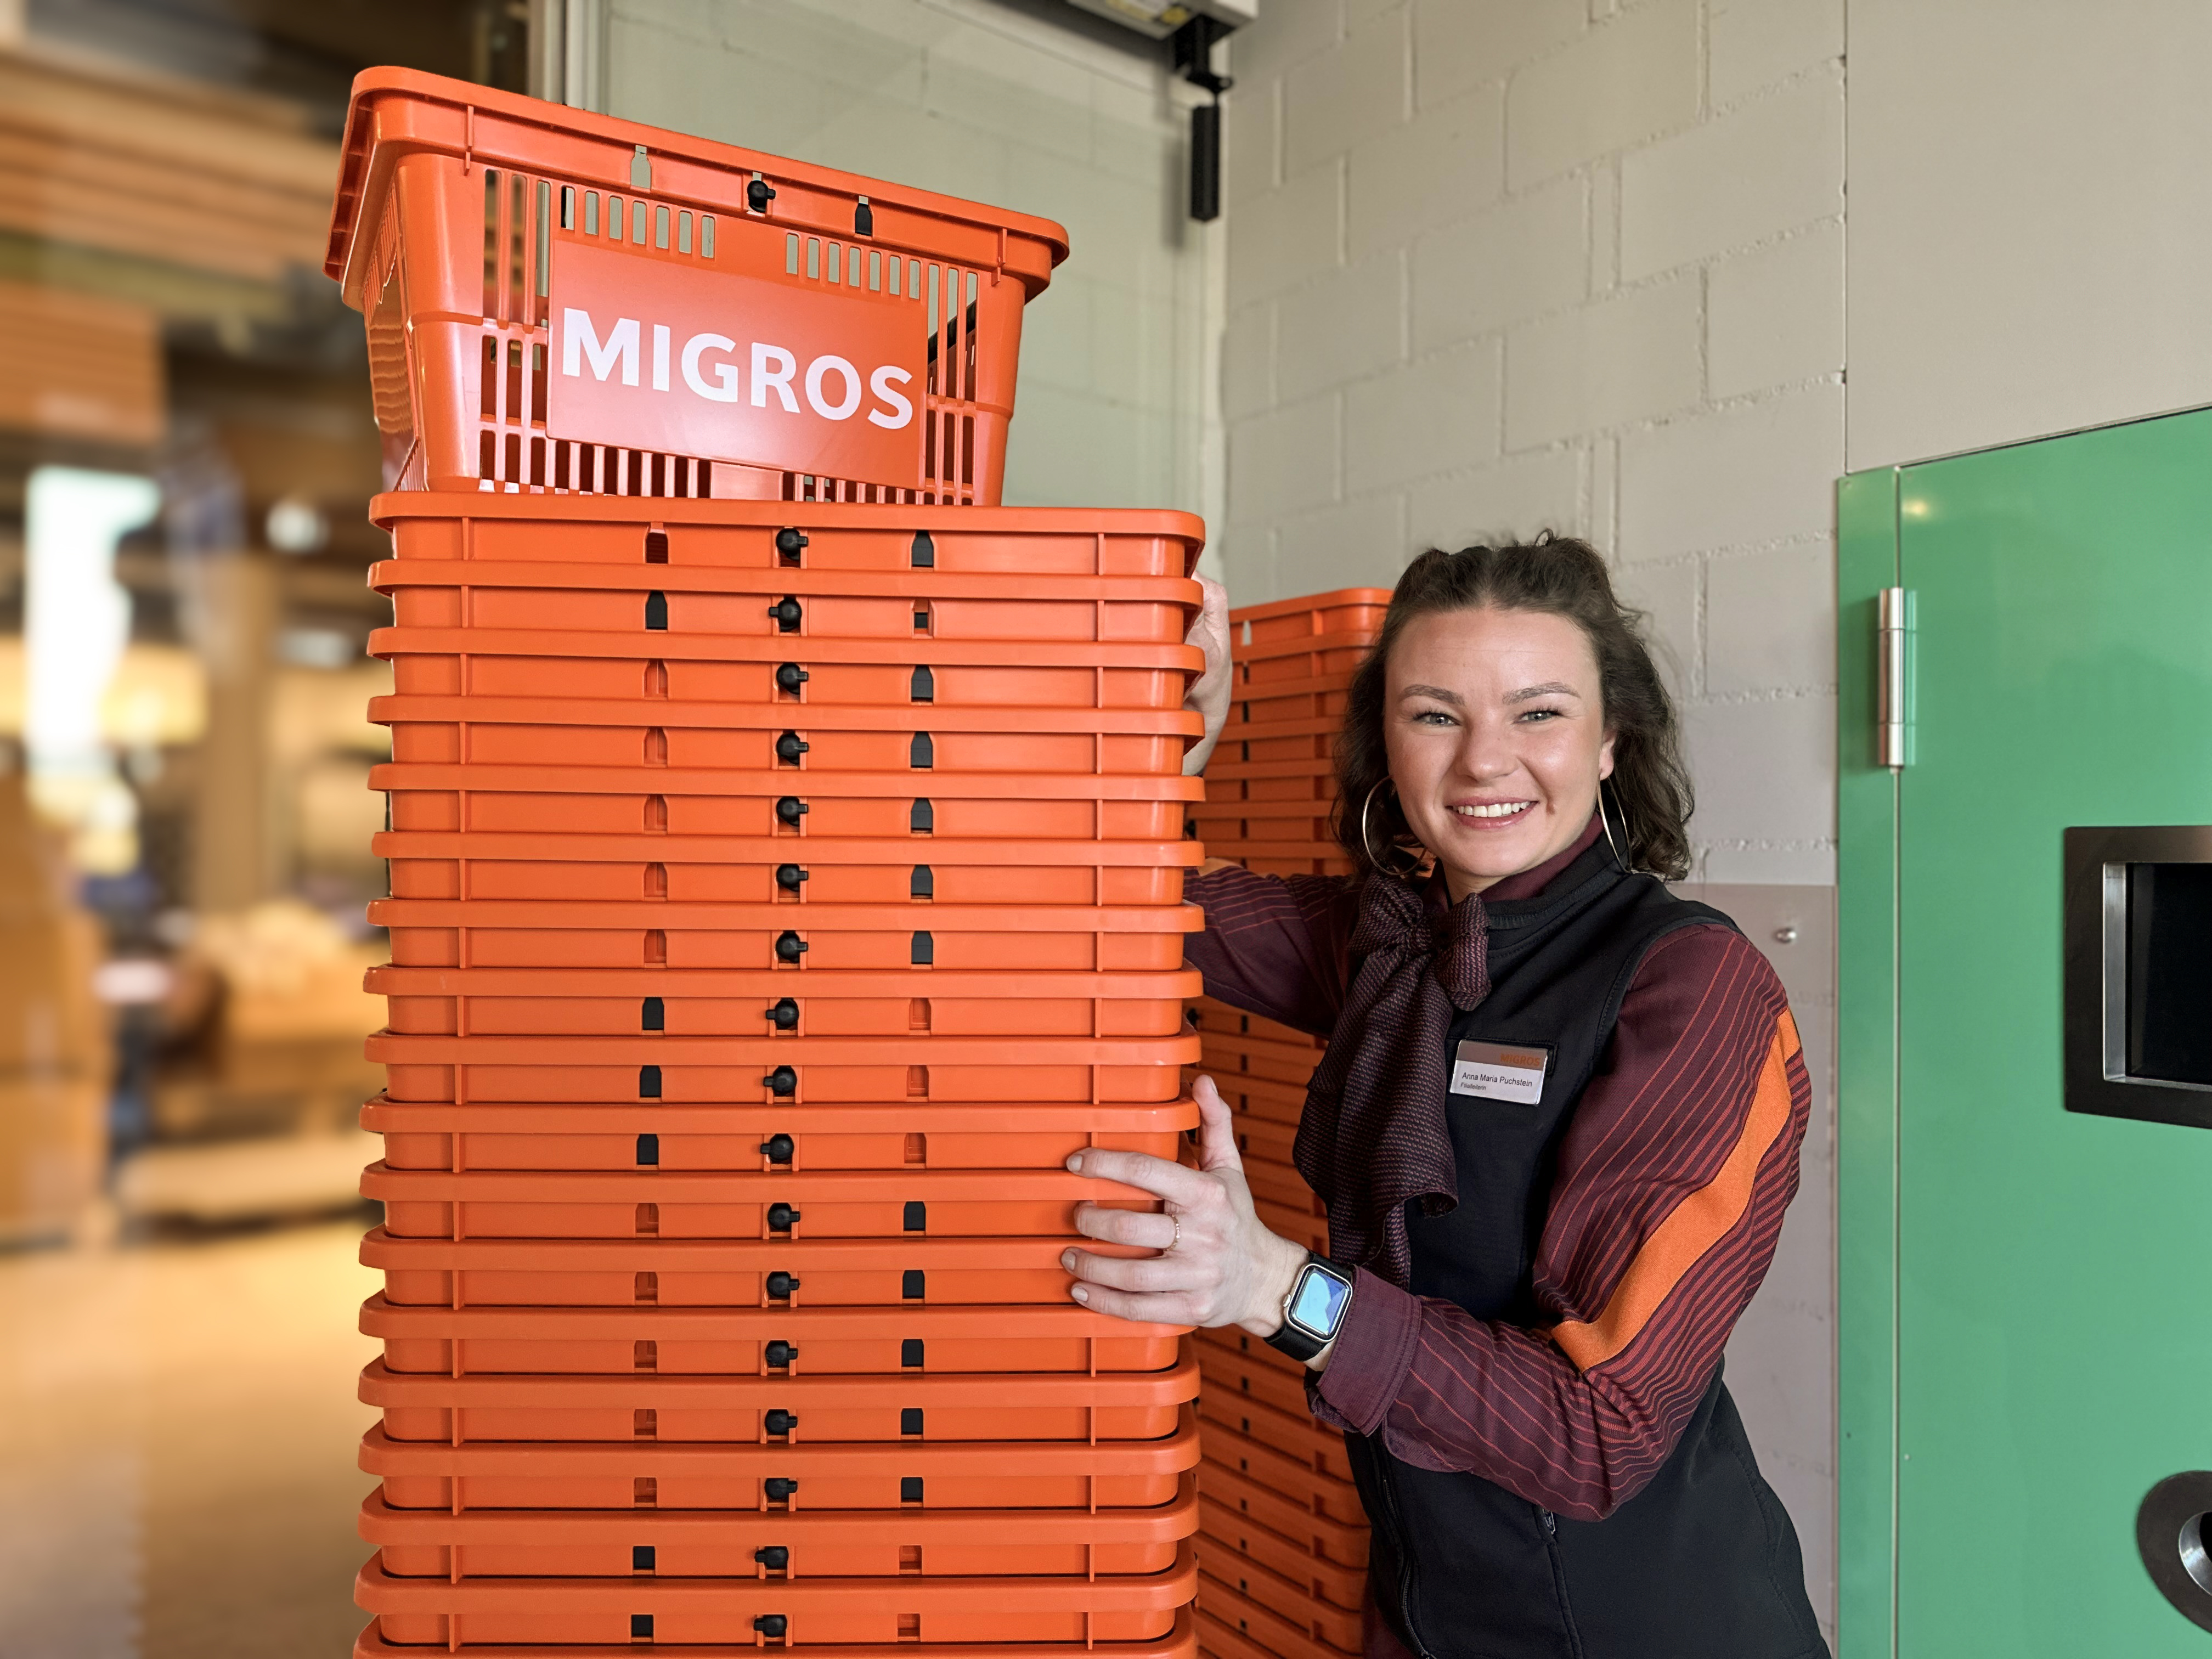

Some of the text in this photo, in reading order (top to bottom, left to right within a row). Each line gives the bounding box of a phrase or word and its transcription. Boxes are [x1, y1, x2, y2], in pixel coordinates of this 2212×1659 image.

[562, 307, 913, 429] MIGROS
[1500, 1054, 1541, 1066] MIGROS
[1462, 1072, 1532, 1087] Anna Maria Puchstein
